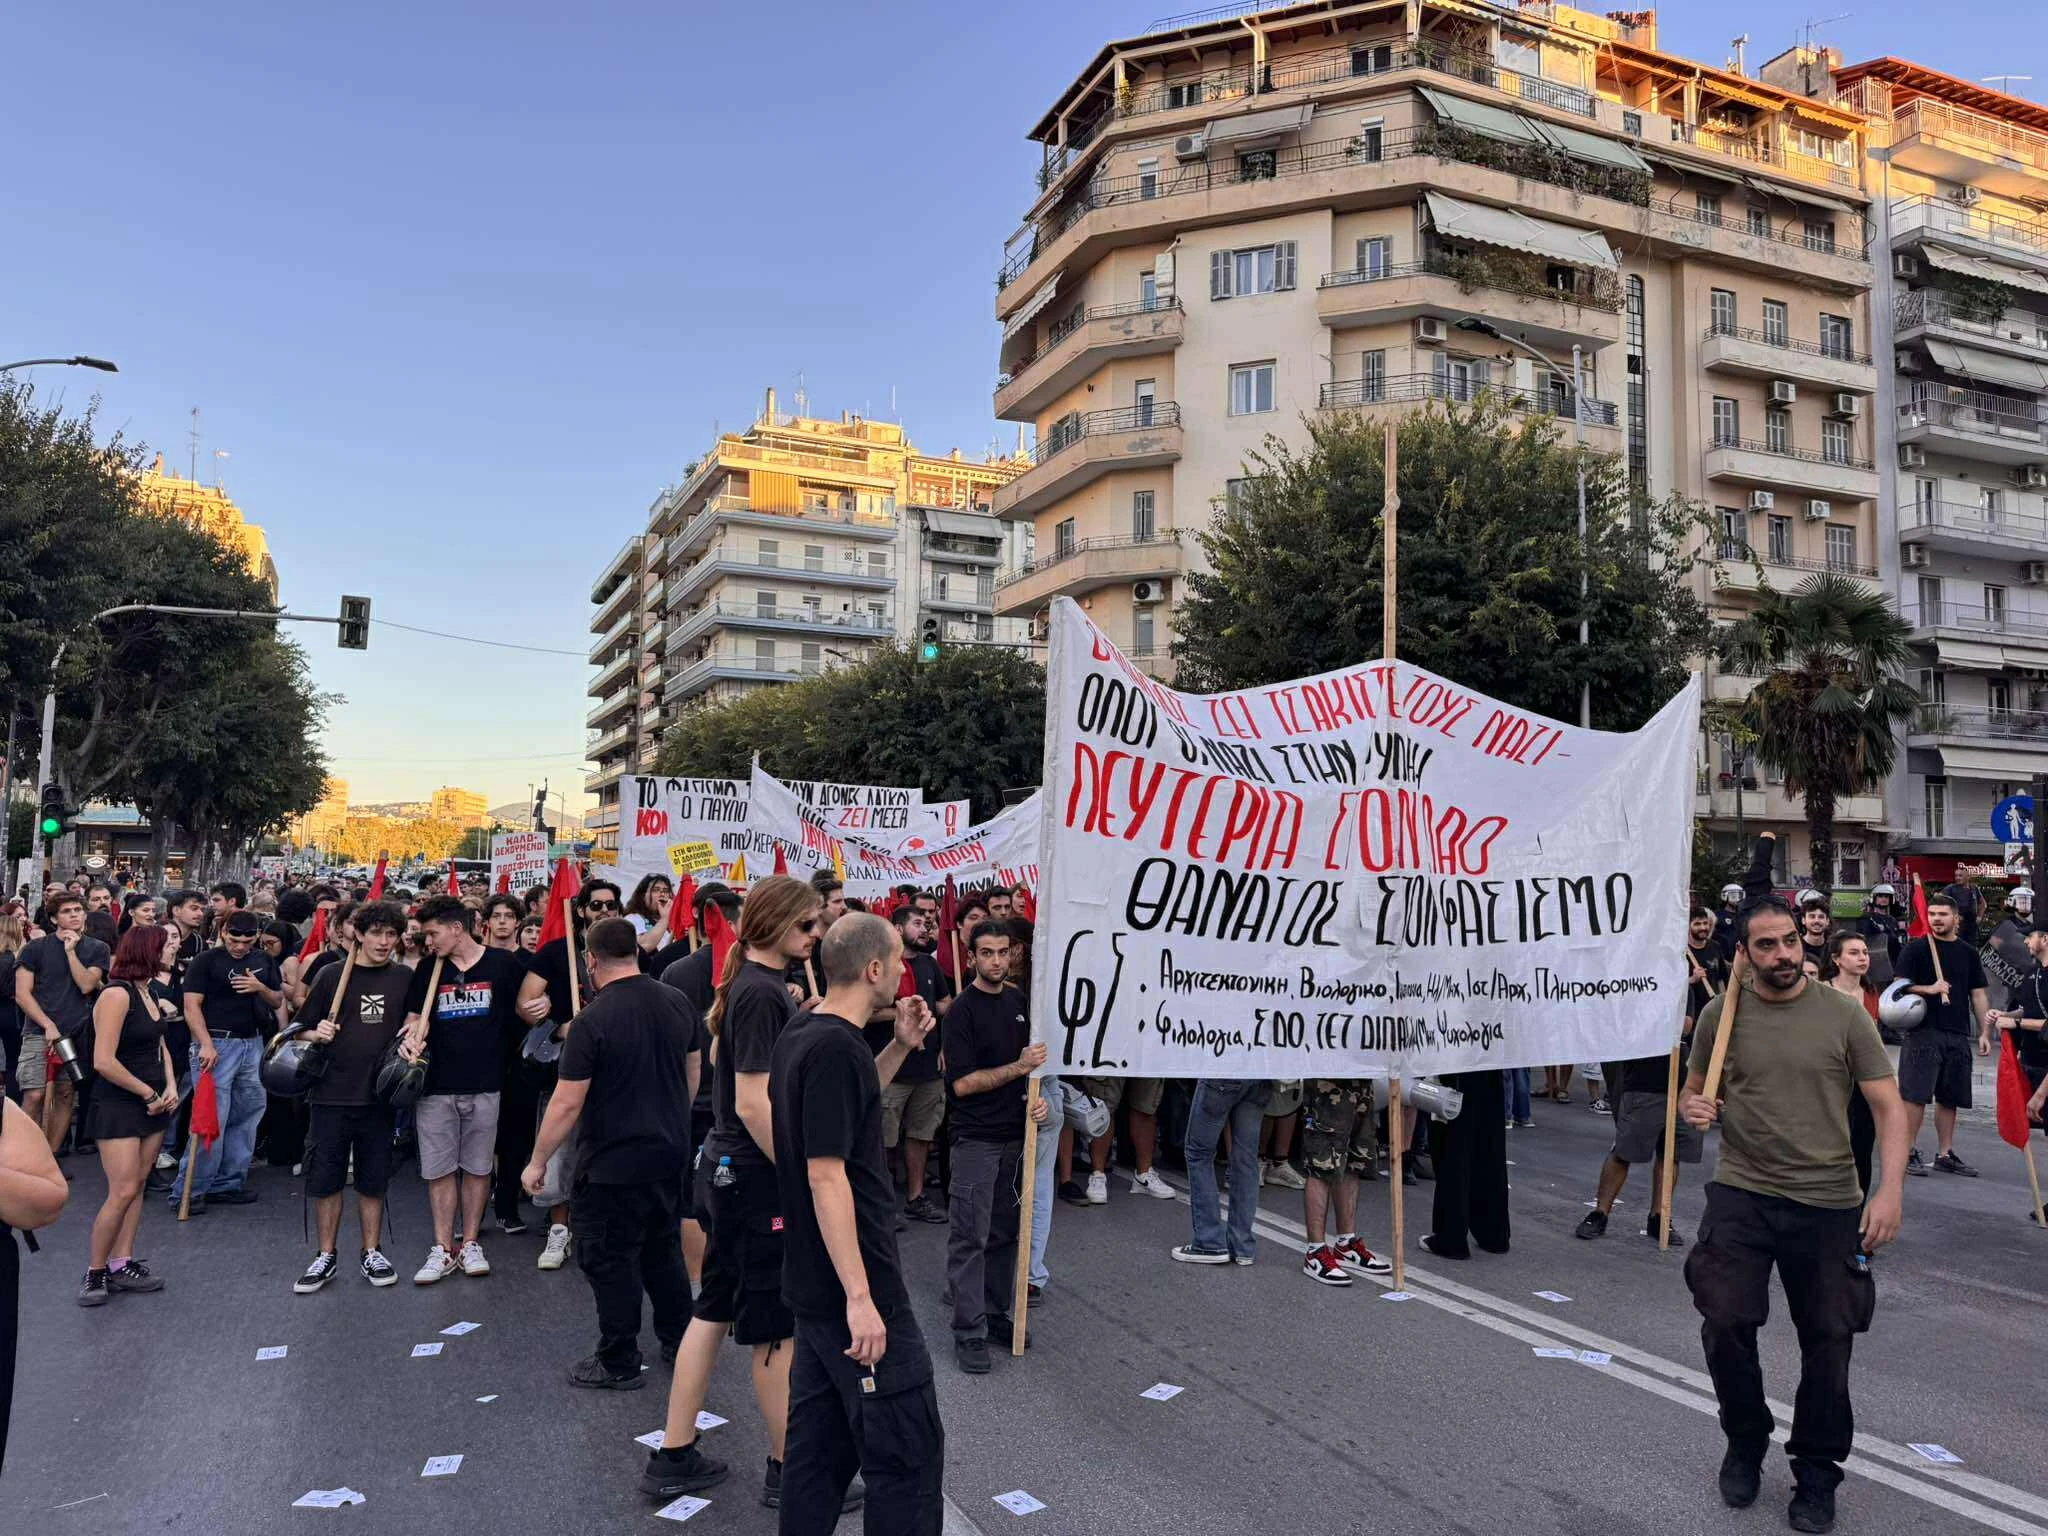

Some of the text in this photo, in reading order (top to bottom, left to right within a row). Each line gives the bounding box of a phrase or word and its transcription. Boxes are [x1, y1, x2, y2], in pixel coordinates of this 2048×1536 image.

[1202, 695, 1262, 739] ΖΕΙ
[635, 777, 658, 808] ΤΟ
[1065, 742, 1304, 871] ΛΕΥΤΕΡΙΑ
[1126, 857, 1344, 947] ΘΑΝΑΤΟΣ
